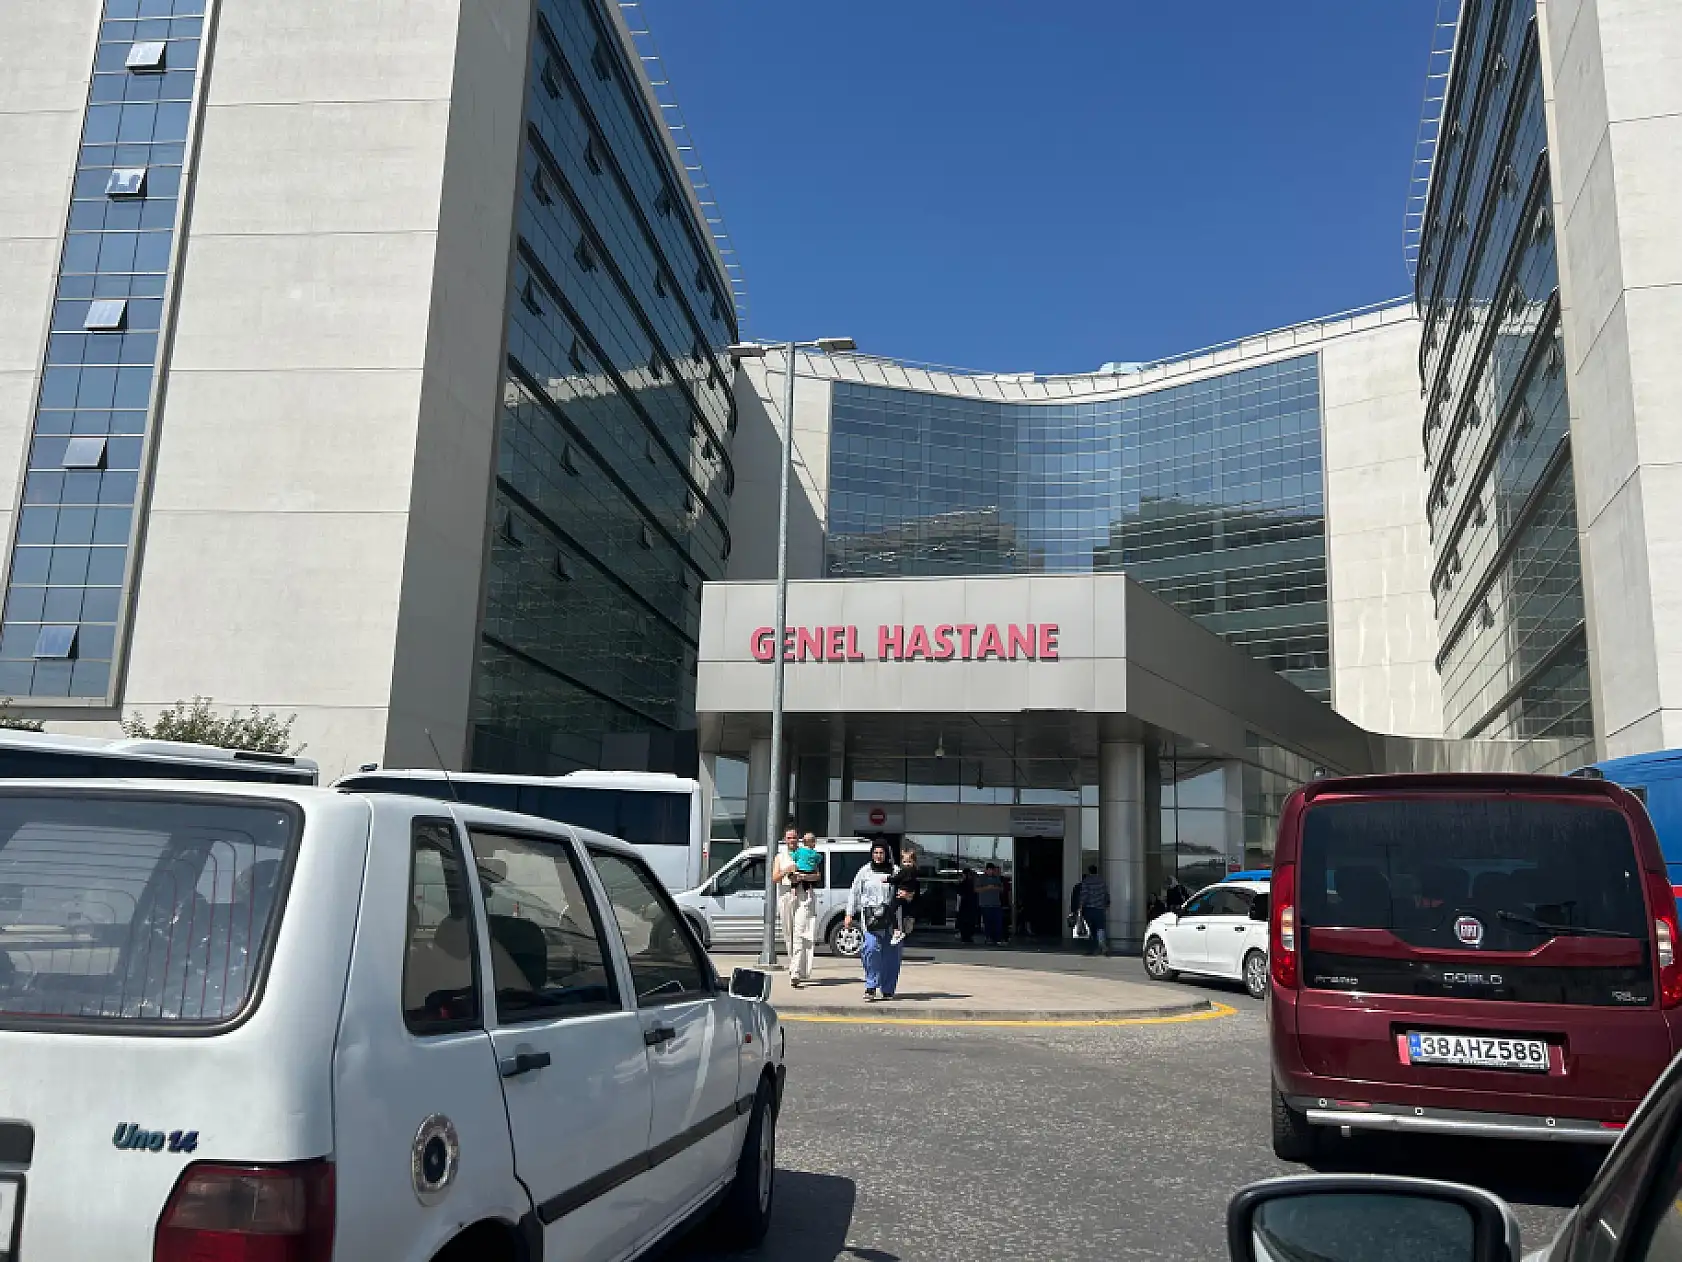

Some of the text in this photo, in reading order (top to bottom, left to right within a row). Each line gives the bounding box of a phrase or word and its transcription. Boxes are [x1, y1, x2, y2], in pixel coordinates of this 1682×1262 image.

[878, 623, 1060, 662] HASTANE
[1443, 972, 1503, 985] DOBLO
[1423, 1037, 1542, 1062] 38AHZ586
[113, 1122, 166, 1152] Uno
